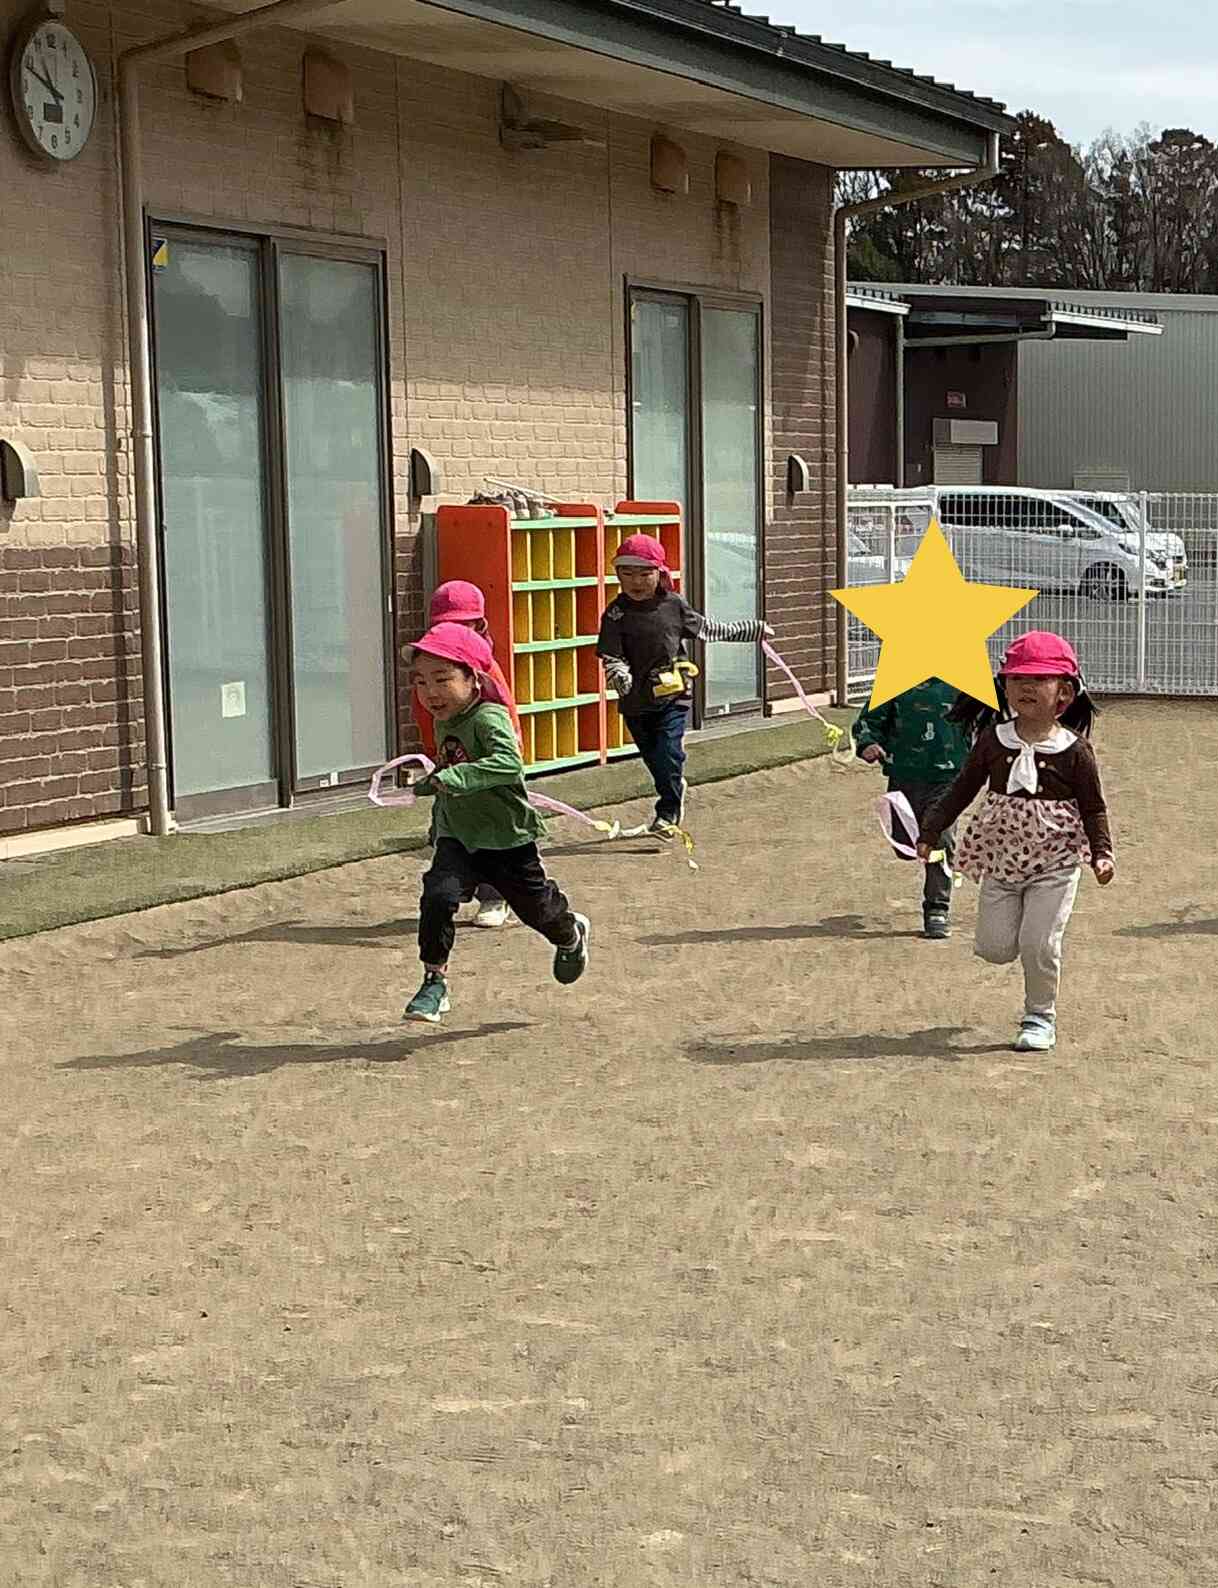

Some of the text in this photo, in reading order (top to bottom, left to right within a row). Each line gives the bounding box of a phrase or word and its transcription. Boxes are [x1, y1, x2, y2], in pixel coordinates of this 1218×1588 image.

[46, 33, 57, 49] 12
[72, 61, 80, 78] 2
[76, 88, 82, 104] 3
[73, 113, 80, 129] 4
[51, 134, 57, 149] 6
[65, 127, 71, 145] 5
